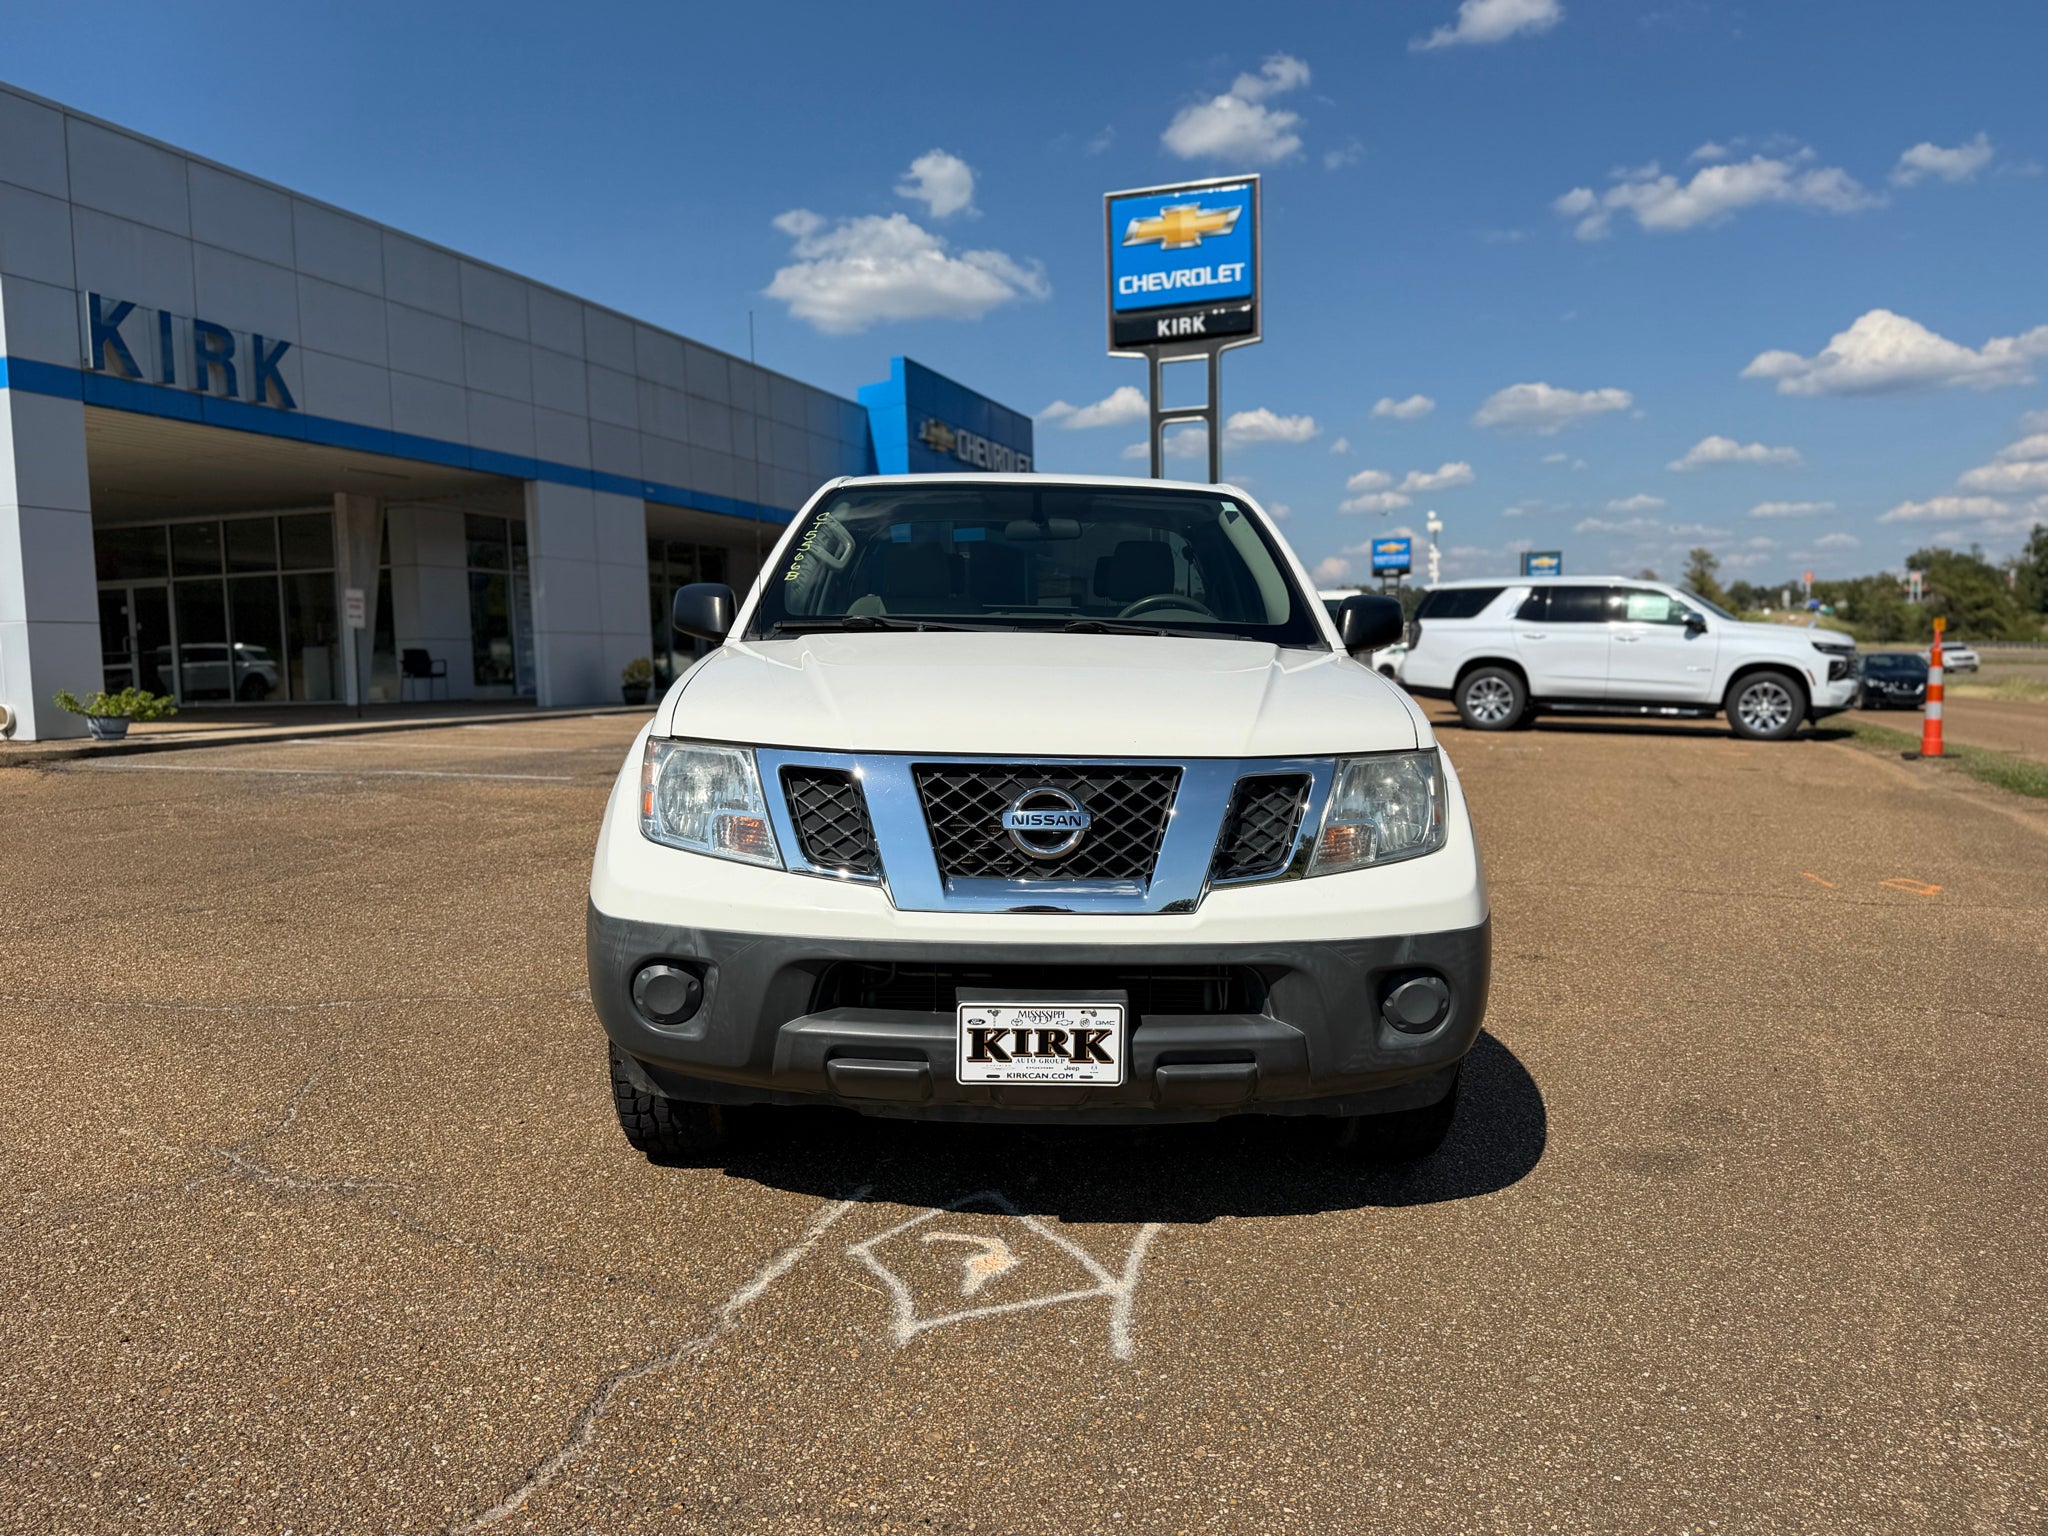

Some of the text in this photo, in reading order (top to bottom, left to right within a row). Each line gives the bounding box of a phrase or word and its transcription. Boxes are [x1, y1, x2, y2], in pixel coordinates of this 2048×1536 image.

[1119, 263, 1245, 295] CHEVROLET
[1157, 315, 1206, 337] KIRK
[86, 290, 298, 409] KIRK
[956, 428, 1032, 473] CHEVROLET
[1011, 814, 1082, 827] NISSAN
[1018, 1010, 1065, 1024] MISSISSIPPI
[967, 1027, 1114, 1064] KIRK
